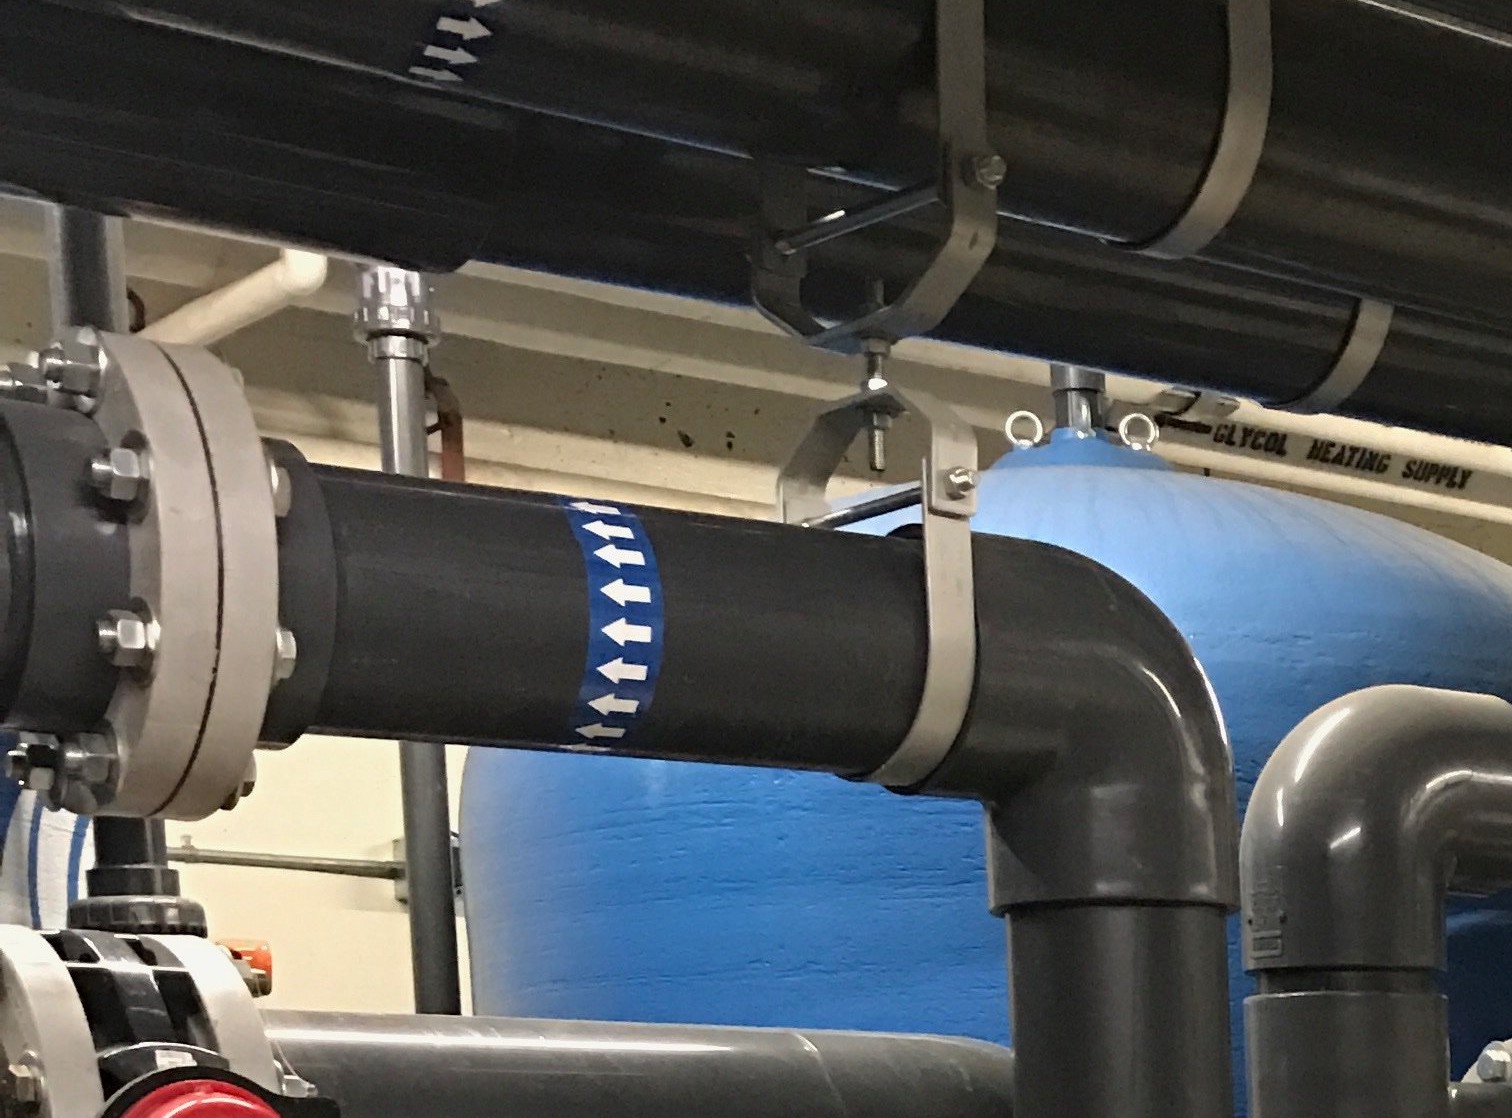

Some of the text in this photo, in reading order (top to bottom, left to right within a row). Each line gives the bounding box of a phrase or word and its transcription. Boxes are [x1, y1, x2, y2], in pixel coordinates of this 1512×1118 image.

[1213, 423, 1474, 490] GLYCOL HEATING SUPPLY
